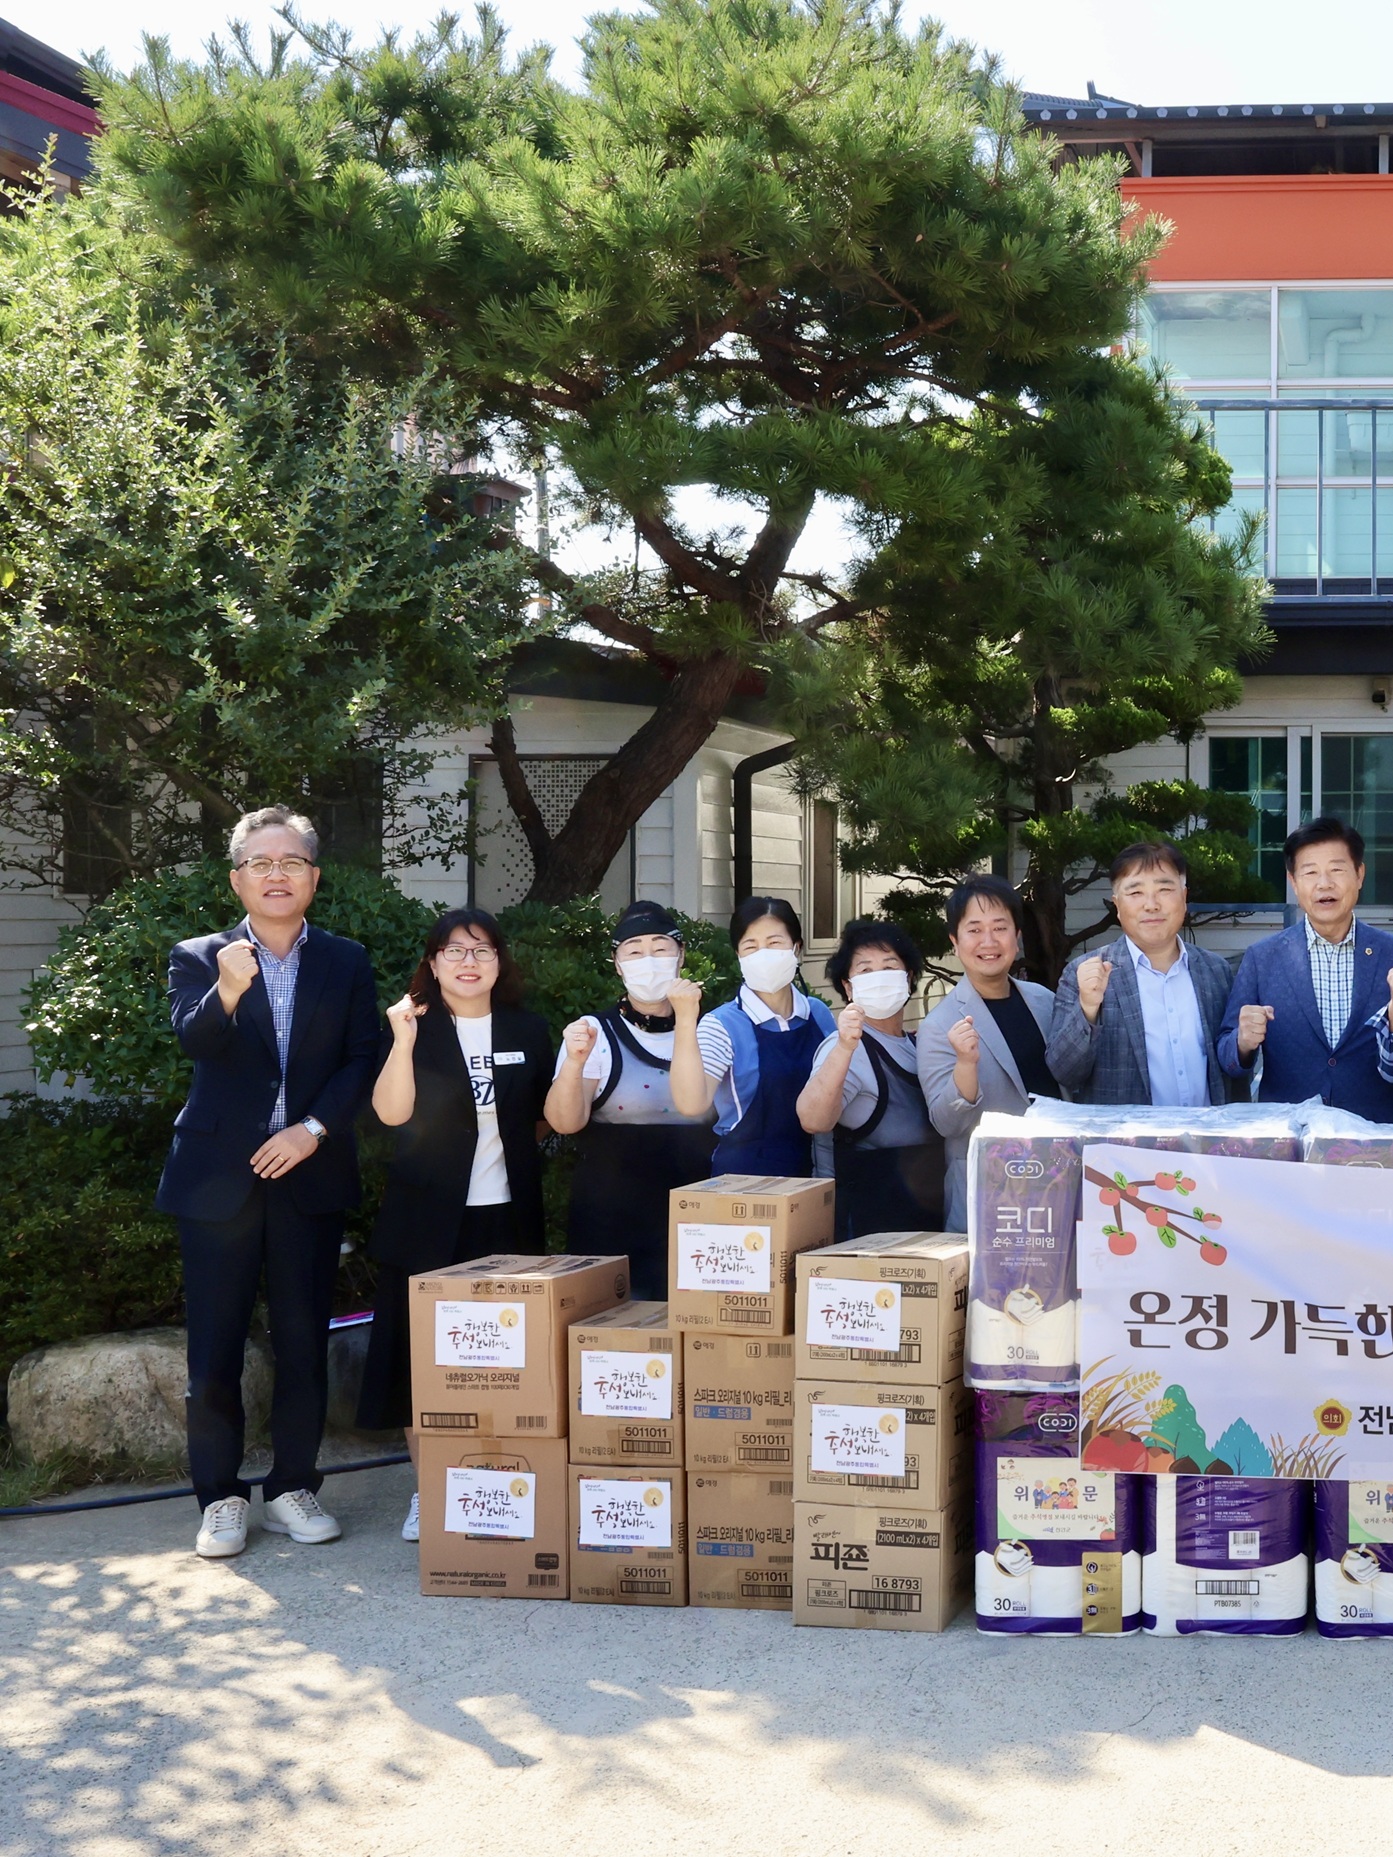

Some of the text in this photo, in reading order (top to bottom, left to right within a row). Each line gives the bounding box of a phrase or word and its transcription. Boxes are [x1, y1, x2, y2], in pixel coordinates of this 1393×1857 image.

[996, 1206, 1052, 1233] 코디
[992, 1236, 1055, 1248] 순수 프리미엄
[708, 1242, 745, 1261] 행복한
[691, 1250, 719, 1273] 추석
[725, 1295, 767, 1307] 5011011
[839, 1298, 876, 1317] 행복한
[821, 1305, 849, 1329] 추석
[1124, 1291, 1229, 1350] 온정
[1007, 1347, 1024, 1359] 30
[612, 1369, 647, 1388] 행복한
[594, 1376, 622, 1399] 추석
[694, 1389, 716, 1402] 스파크
[718, 1389, 741, 1404] 오리지널
[753, 1390, 763, 1405] kg
[1323, 1414, 1342, 1424] 의회
[625, 1427, 667, 1437] 5011011
[742, 1434, 785, 1445] 5011011
[843, 1424, 880, 1443] 행복한
[825, 1431, 853, 1455] 추석
[608, 1498, 645, 1516] 행복한
[592, 1505, 619, 1528] 추석
[697, 1527, 718, 1539] 스파크
[720, 1527, 743, 1541] 오리지널
[755, 1528, 765, 1543] kg
[810, 1542, 869, 1571] 피죤
[624, 1568, 667, 1578] 5011011
[745, 1572, 788, 1582] 5011011
[875, 1578, 919, 1590] 16 8793
[993, 1598, 1011, 1611] 30
[1340, 1605, 1358, 1618] 30
